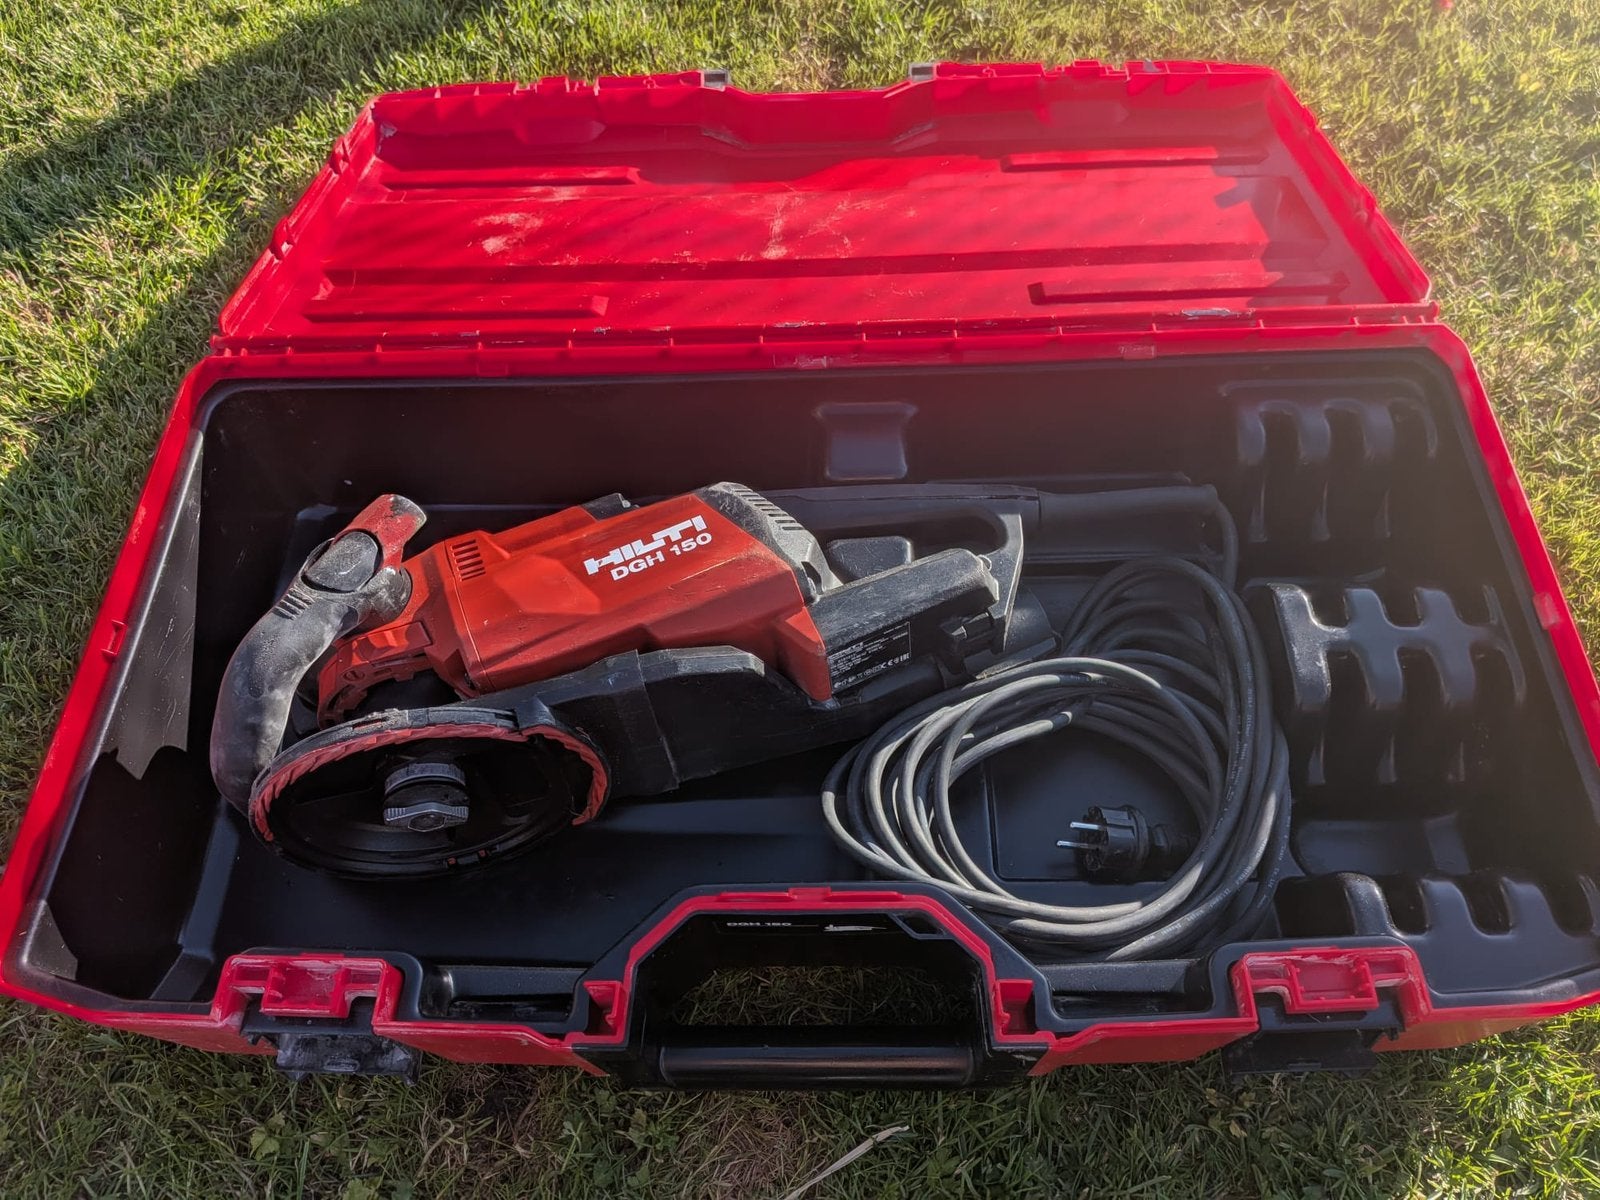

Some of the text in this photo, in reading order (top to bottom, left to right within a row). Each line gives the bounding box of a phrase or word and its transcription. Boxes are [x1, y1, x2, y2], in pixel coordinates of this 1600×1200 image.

[583, 515, 708, 575] HILTI
[610, 532, 713, 581] DGH 150
